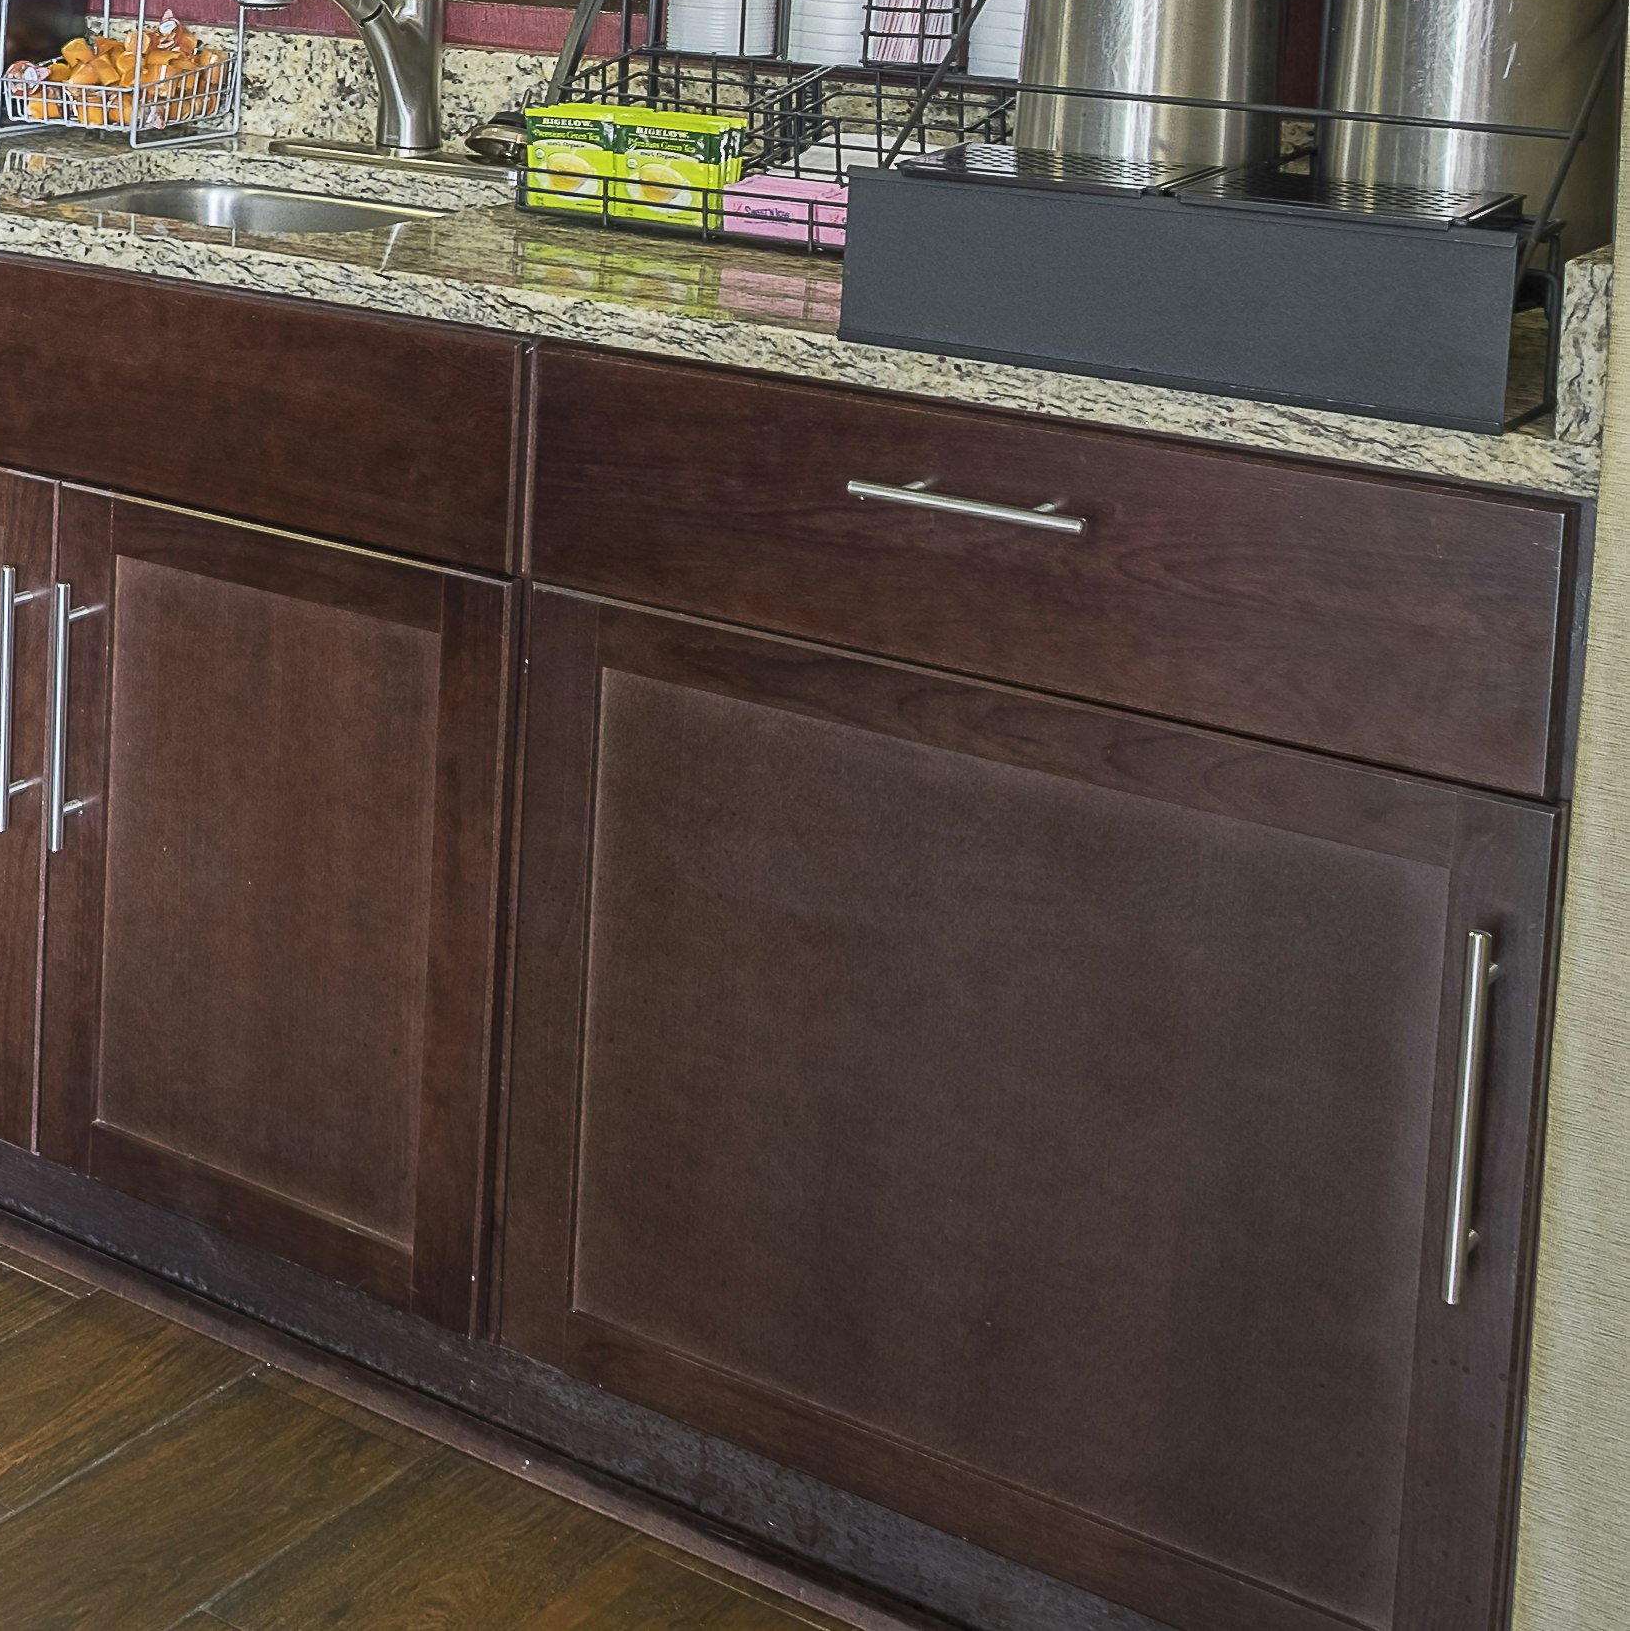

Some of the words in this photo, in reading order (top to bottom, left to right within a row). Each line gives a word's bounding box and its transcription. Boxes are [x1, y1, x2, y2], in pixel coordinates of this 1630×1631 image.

[542, 118, 593, 127] BIGELOW
[532, 129, 566, 139] Premium
[566, 130, 588, 139] Green
[635, 126, 690, 138] BIGELOW
[660, 141, 683, 151] Green
[683, 144, 696, 153] Tea
